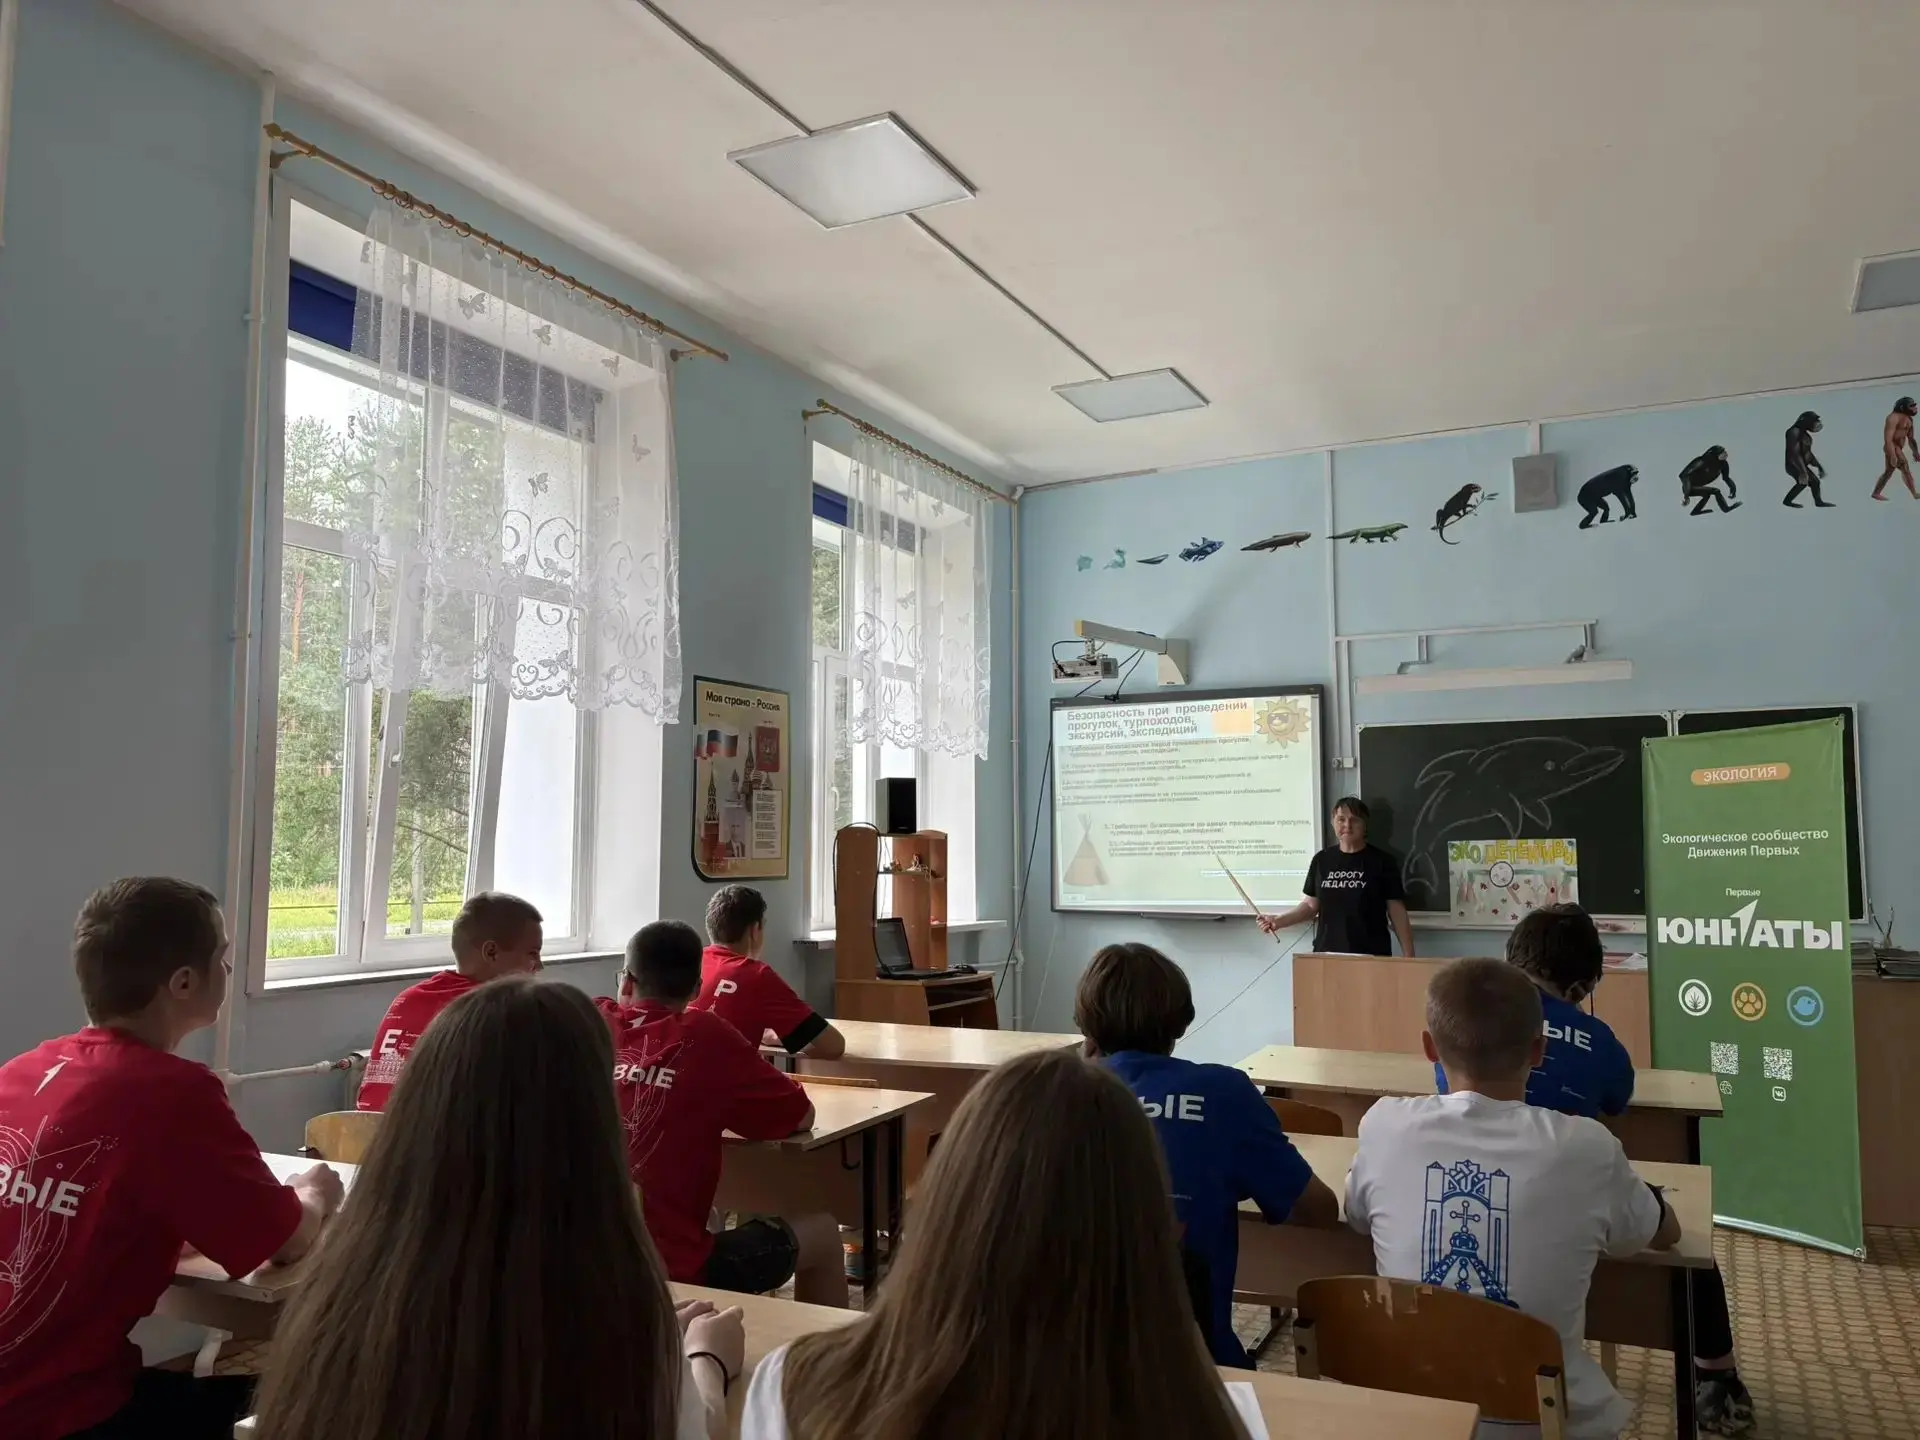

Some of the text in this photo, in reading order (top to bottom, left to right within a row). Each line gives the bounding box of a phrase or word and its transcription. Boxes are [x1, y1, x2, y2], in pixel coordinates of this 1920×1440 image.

[705, 690, 723, 703] Моя
[756, 698, 781, 711] Россия
[1067, 702, 1248, 721] Безопасность при проведении
[1067, 714, 1197, 732] прогулок, турпоходов,
[1067, 724, 1198, 741] экскурсий, экспедиций
[1703, 766, 1778, 783] ЭКОЛОГИЯ
[1662, 829, 1829, 844] Экологическое сообщество
[1688, 845, 1800, 859] Движения Первых
[1327, 871, 1365, 879] ДОРОГУ
[1321, 880, 1367, 888] ПЕДАГОГУ
[1725, 887, 1761, 897] Первые
[1657, 898, 1843, 951] ЮННАТЫ
